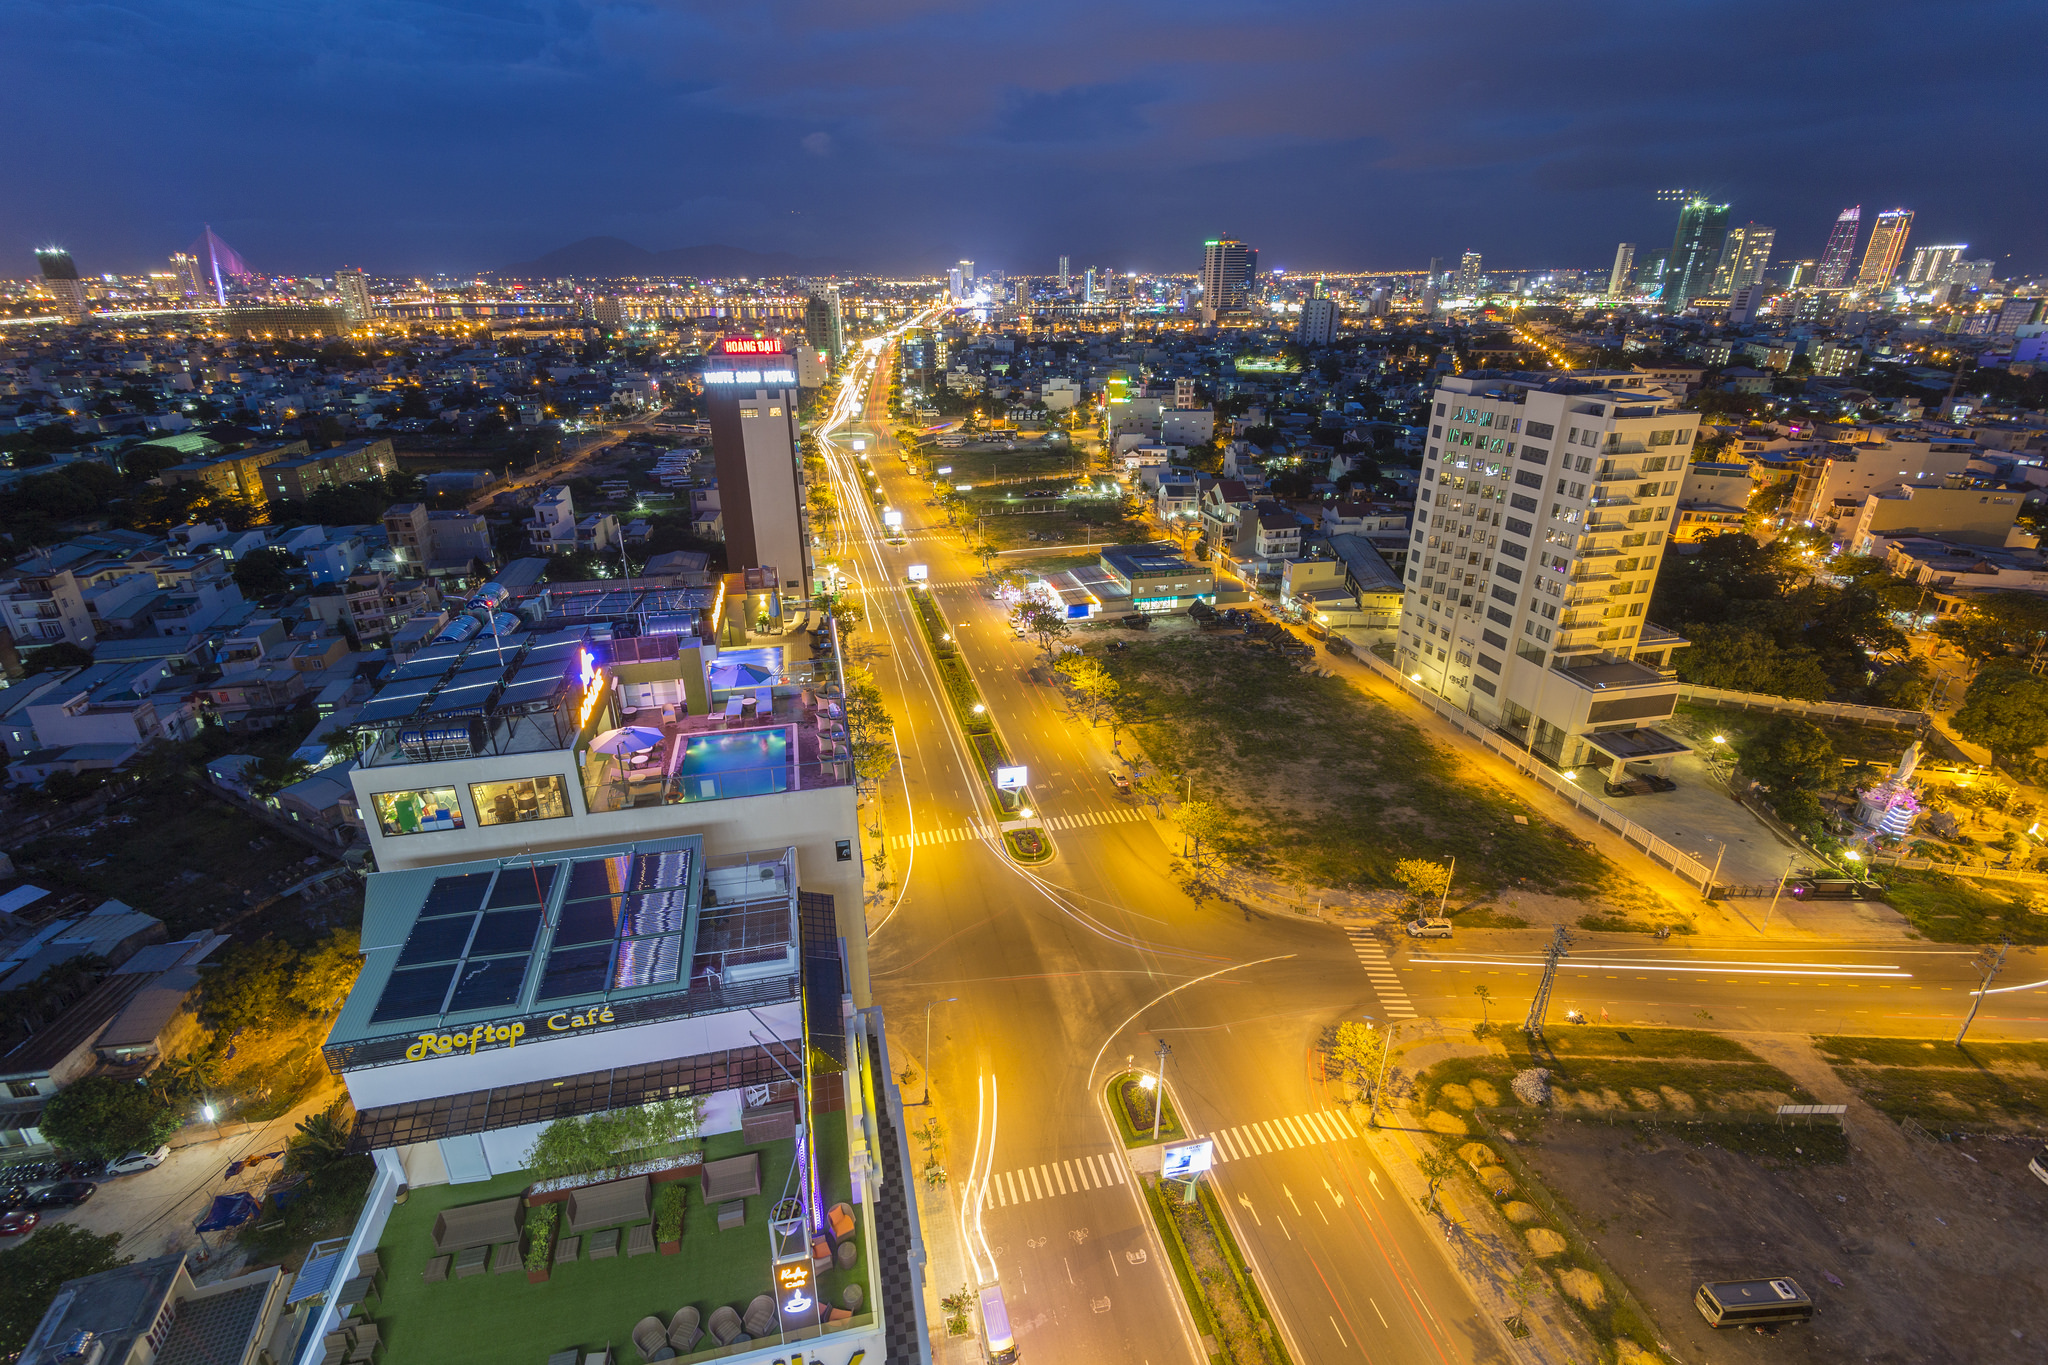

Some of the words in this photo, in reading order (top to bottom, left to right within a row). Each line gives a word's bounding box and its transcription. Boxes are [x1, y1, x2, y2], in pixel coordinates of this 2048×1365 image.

[704, 371, 734, 383] WHITE
[736, 371, 761, 382] SAND
[764, 370, 794, 382] HOTEL
[406, 1021, 525, 1060] Rooftop
[547, 1006, 615, 1030] Café
